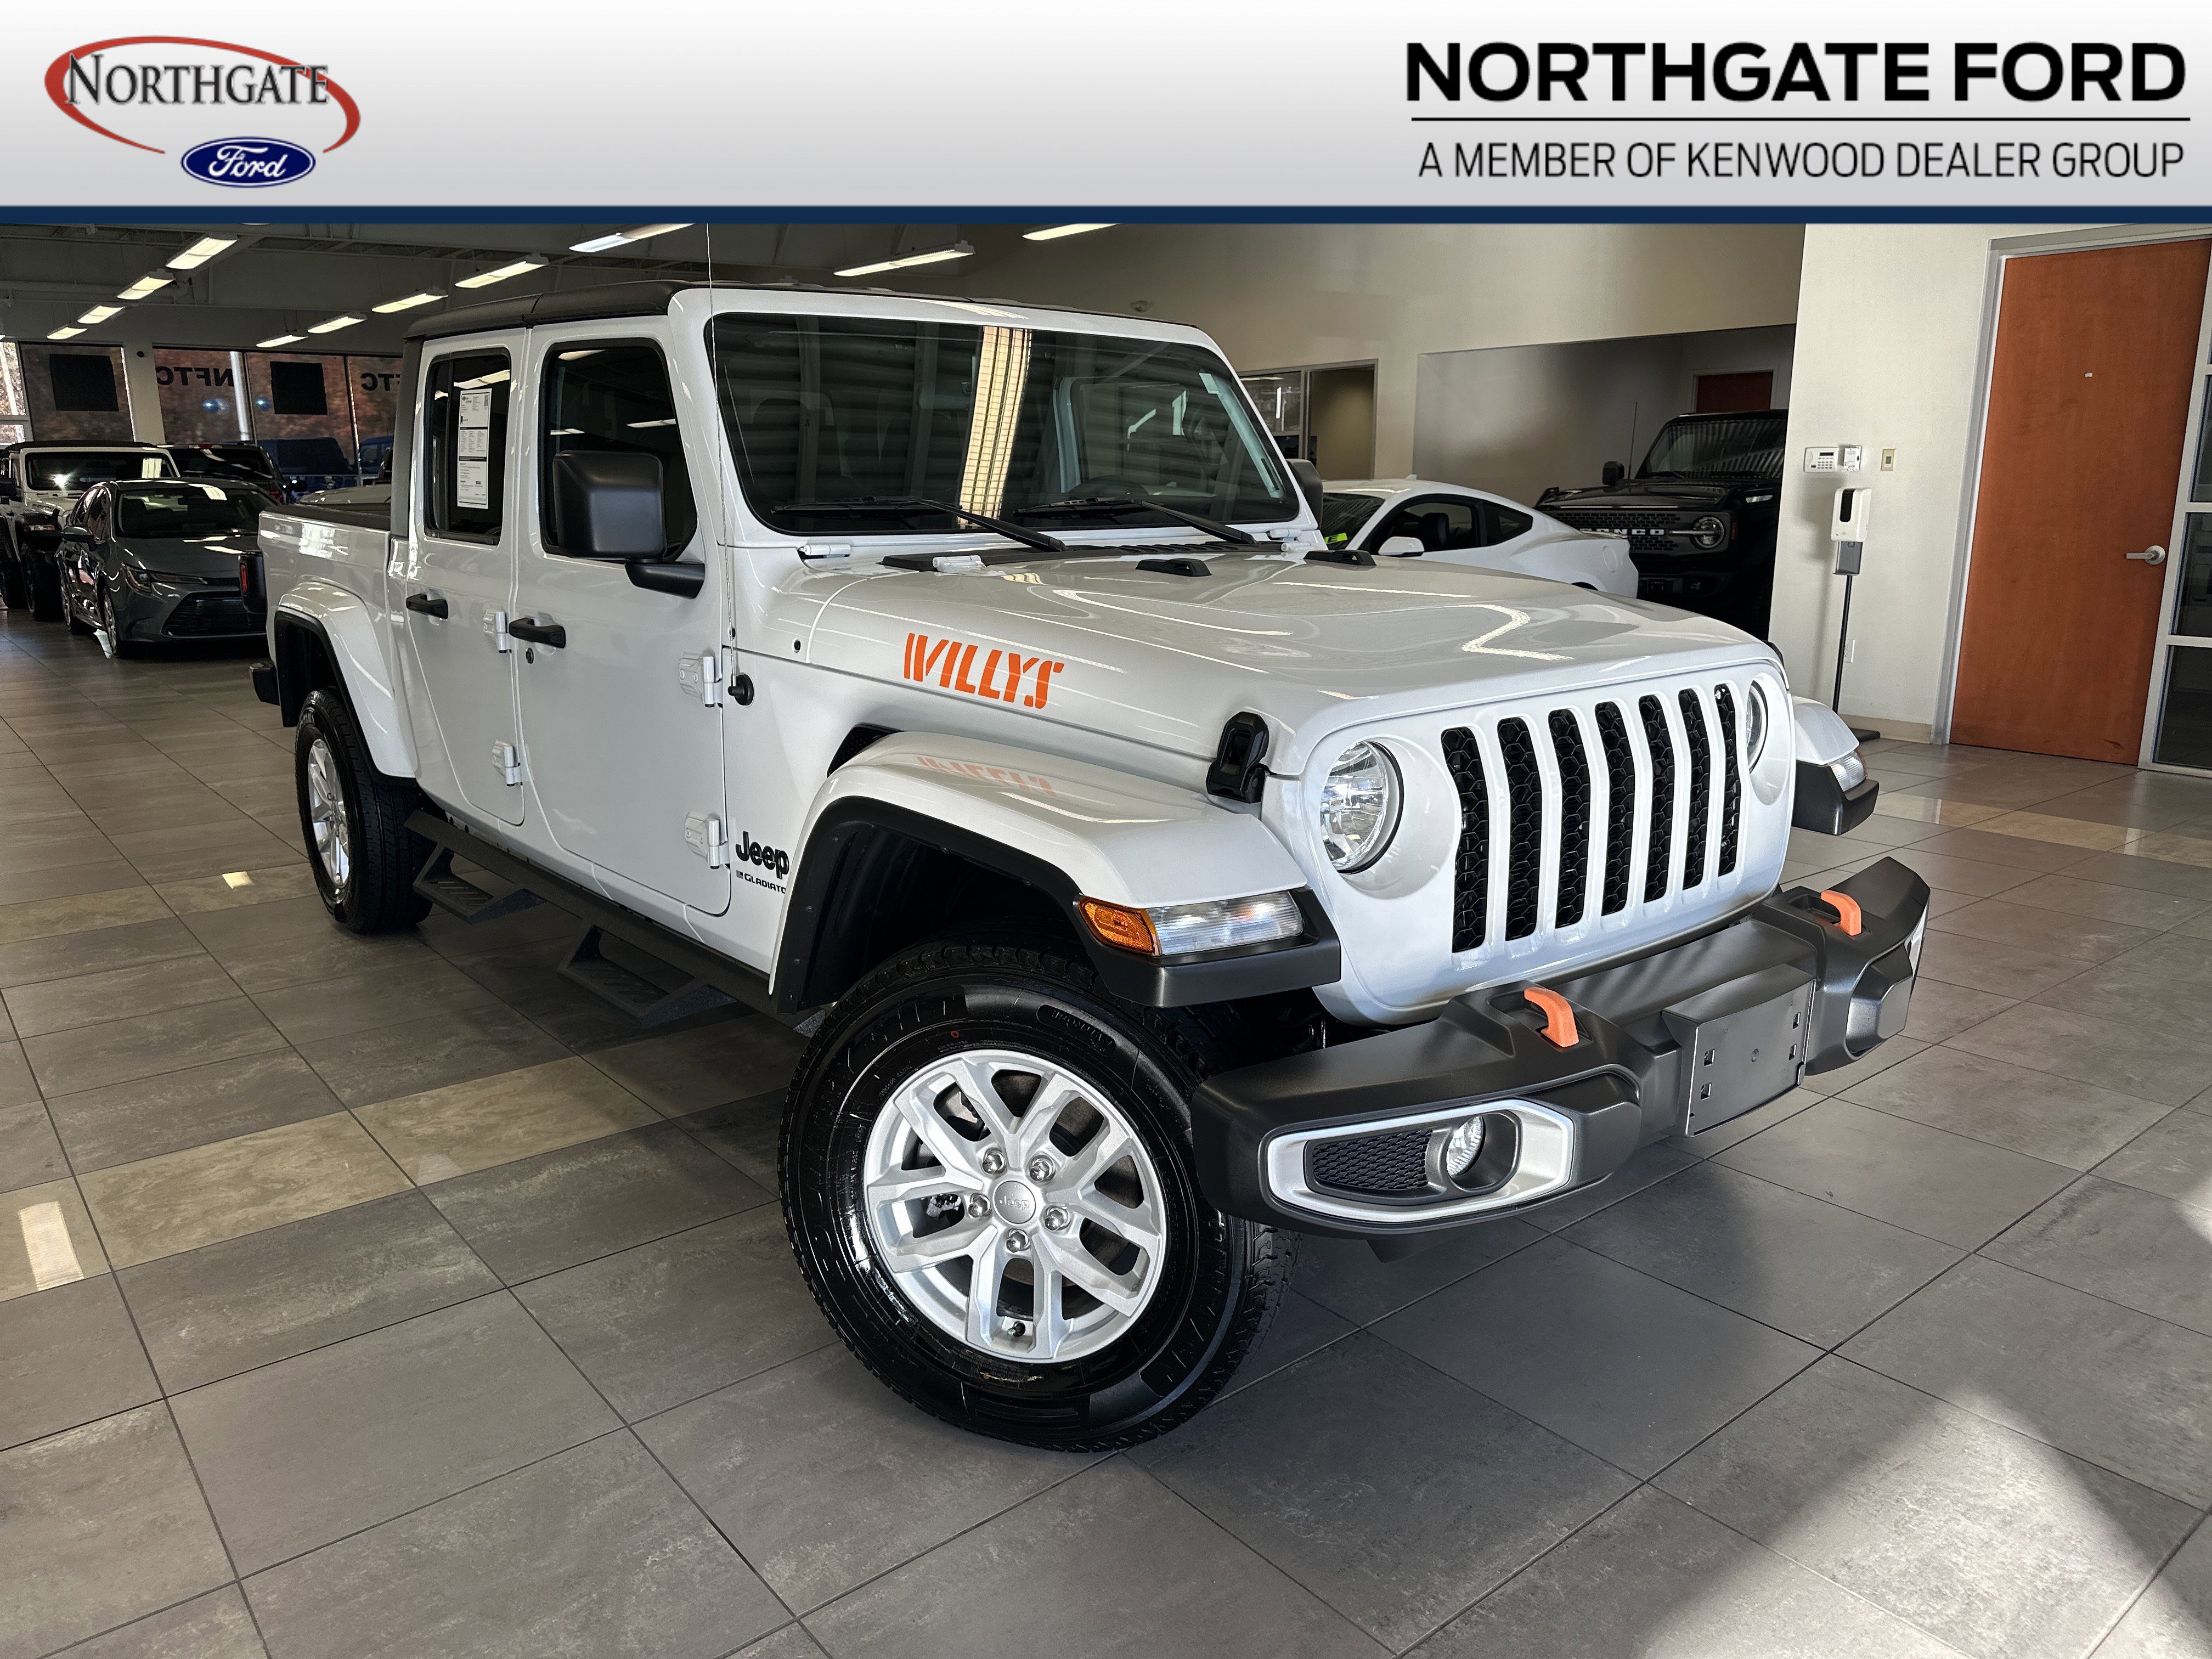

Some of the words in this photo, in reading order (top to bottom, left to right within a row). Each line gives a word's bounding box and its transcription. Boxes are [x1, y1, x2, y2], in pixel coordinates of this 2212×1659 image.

[904, 633, 1064, 709] WILLYS
[735, 830, 789, 880] Jeep
[744, 873, 787, 894] GLADIATO
[999, 1195, 1030, 1211] Jeep
